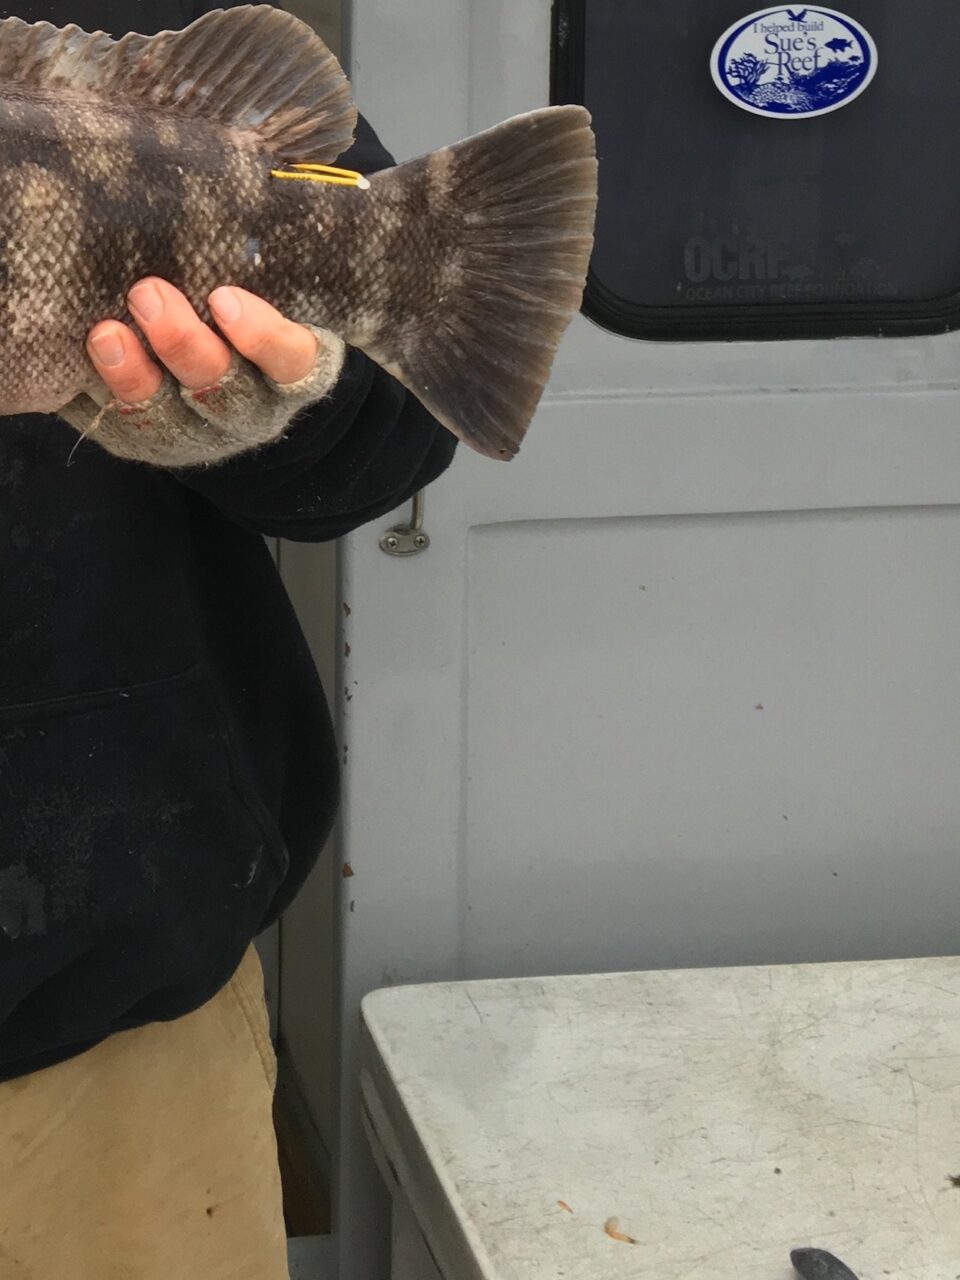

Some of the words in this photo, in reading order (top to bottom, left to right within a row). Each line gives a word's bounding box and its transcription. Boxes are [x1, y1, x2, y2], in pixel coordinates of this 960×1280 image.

[761, 21, 795, 34] helped
[797, 21, 824, 32] build
[764, 32, 817, 55] Sue's
[775, 47, 824, 76] Reef
